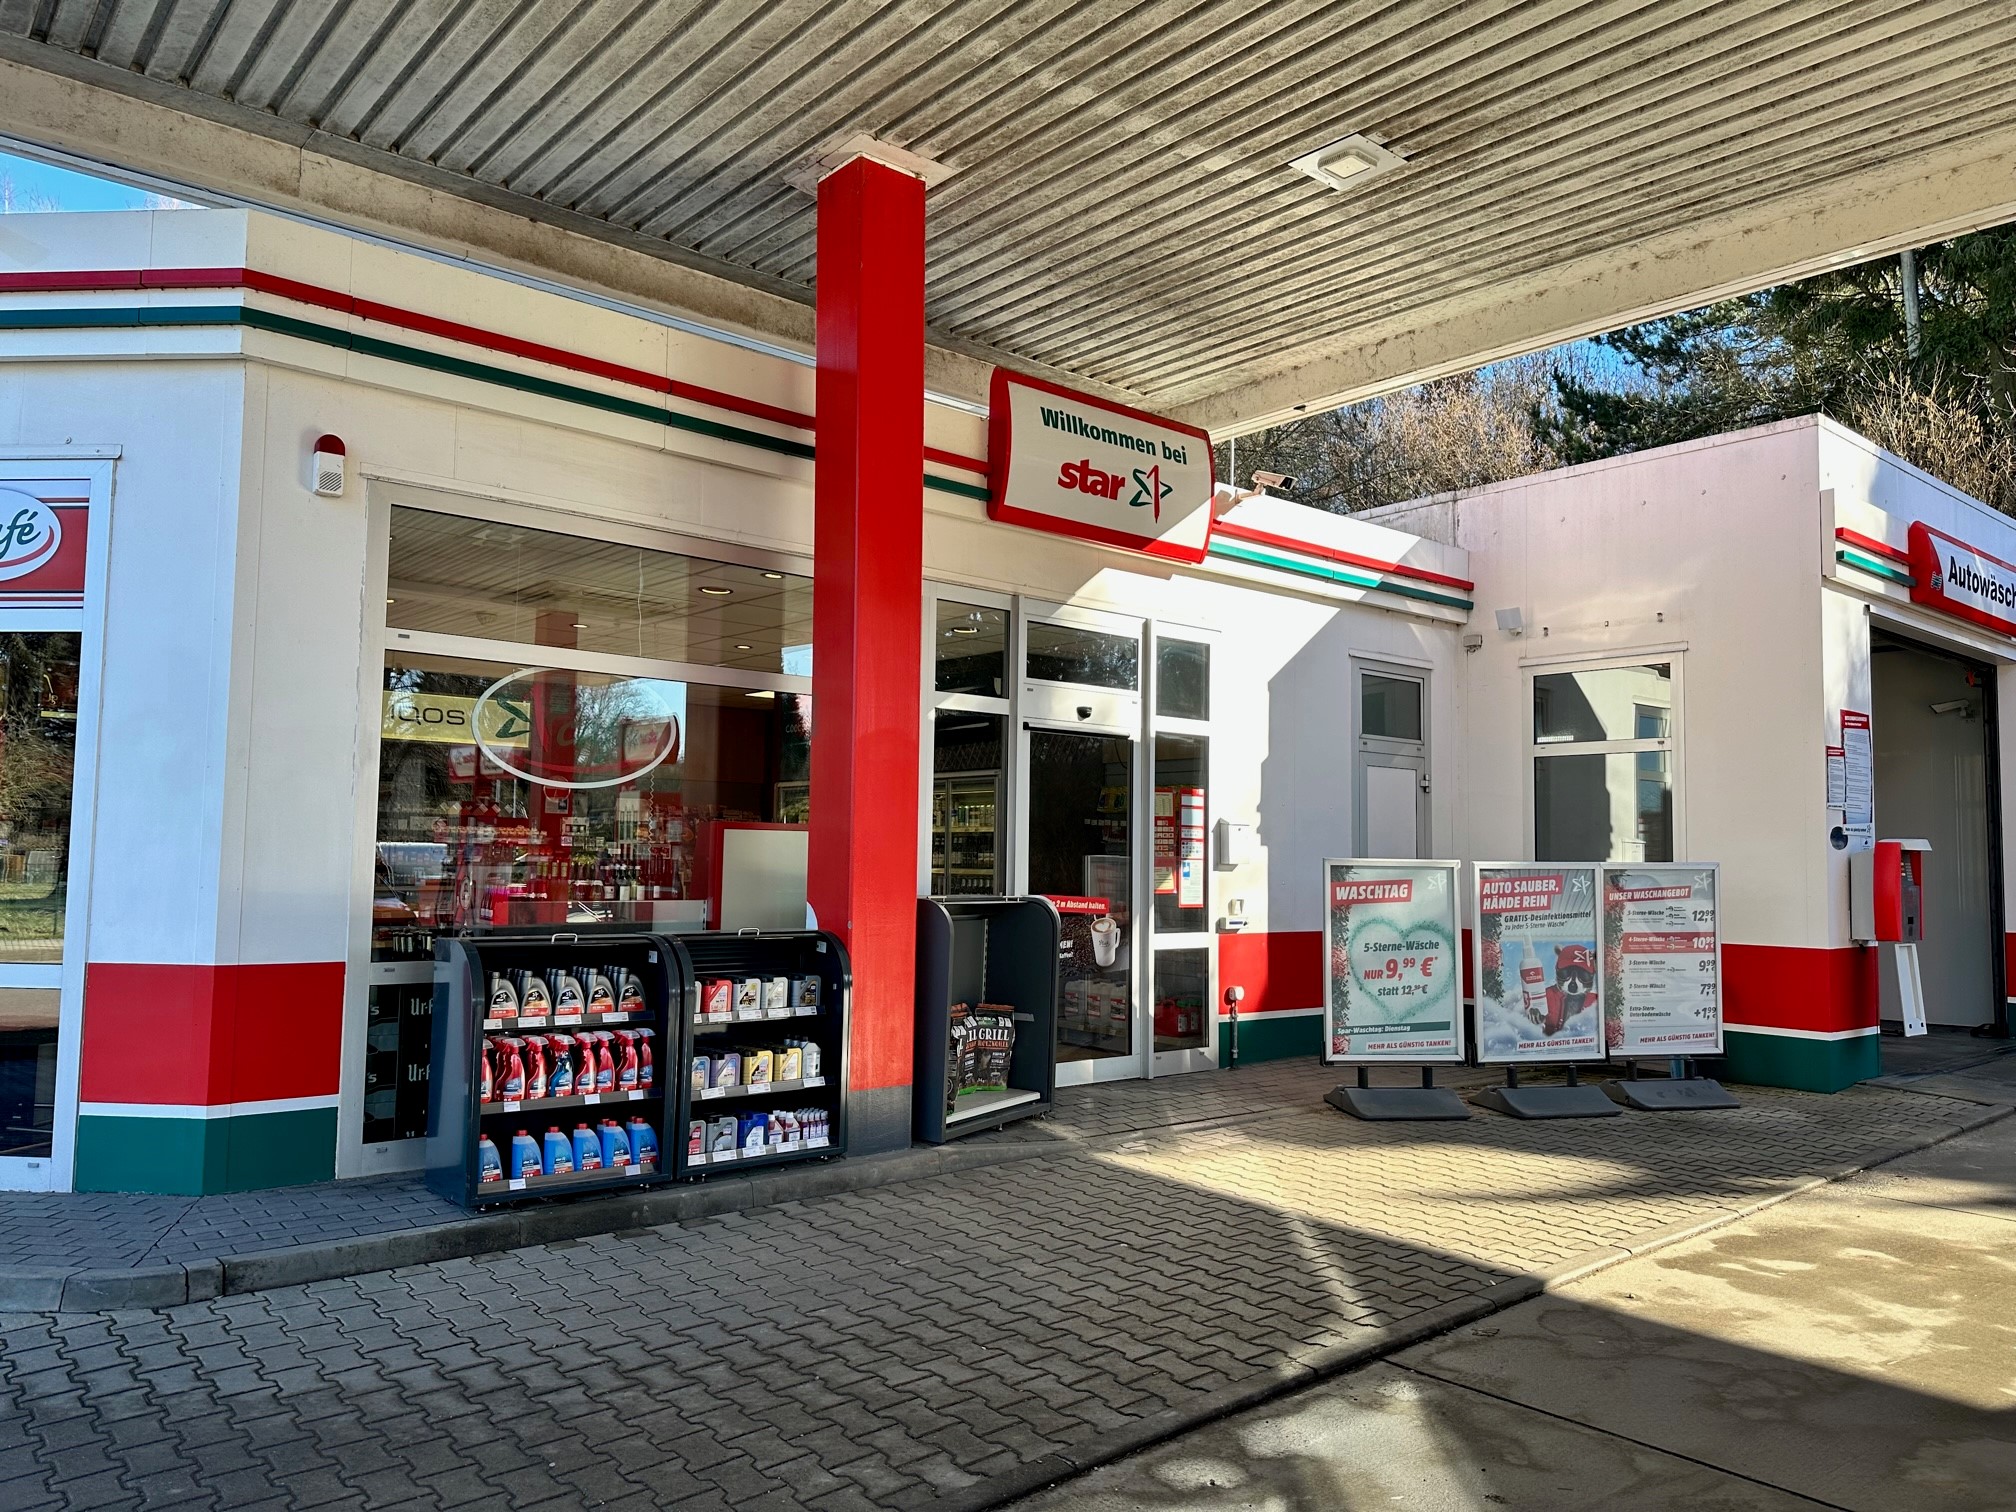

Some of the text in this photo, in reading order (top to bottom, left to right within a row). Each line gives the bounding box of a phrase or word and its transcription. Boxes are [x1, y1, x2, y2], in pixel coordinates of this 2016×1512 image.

[1040, 406, 1187, 465] Willkommen bei
[1058, 459, 1126, 500] star
[1336, 884, 1408, 900] WASCHTAG
[1483, 879, 1559, 895] AUTO SAUBER,
[1609, 888, 1689, 901] UNSER WASCHANGEBOT
[1067, 900, 1088, 909] Abstand
[1483, 895, 1548, 910] HÄNDE REIN
[1364, 940, 1440, 952] 5-Sterne-Wäsche
[1364, 969, 1384, 980] NUR
[1377, 985, 1400, 996] statt
[978, 1028, 1010, 1041] GRILL
[1384, 1025, 1411, 1033] Dienstag
[1399, 1040, 1425, 1048] GÜNSTIG
[1571, 1037, 1595, 1045] TANKEN!
